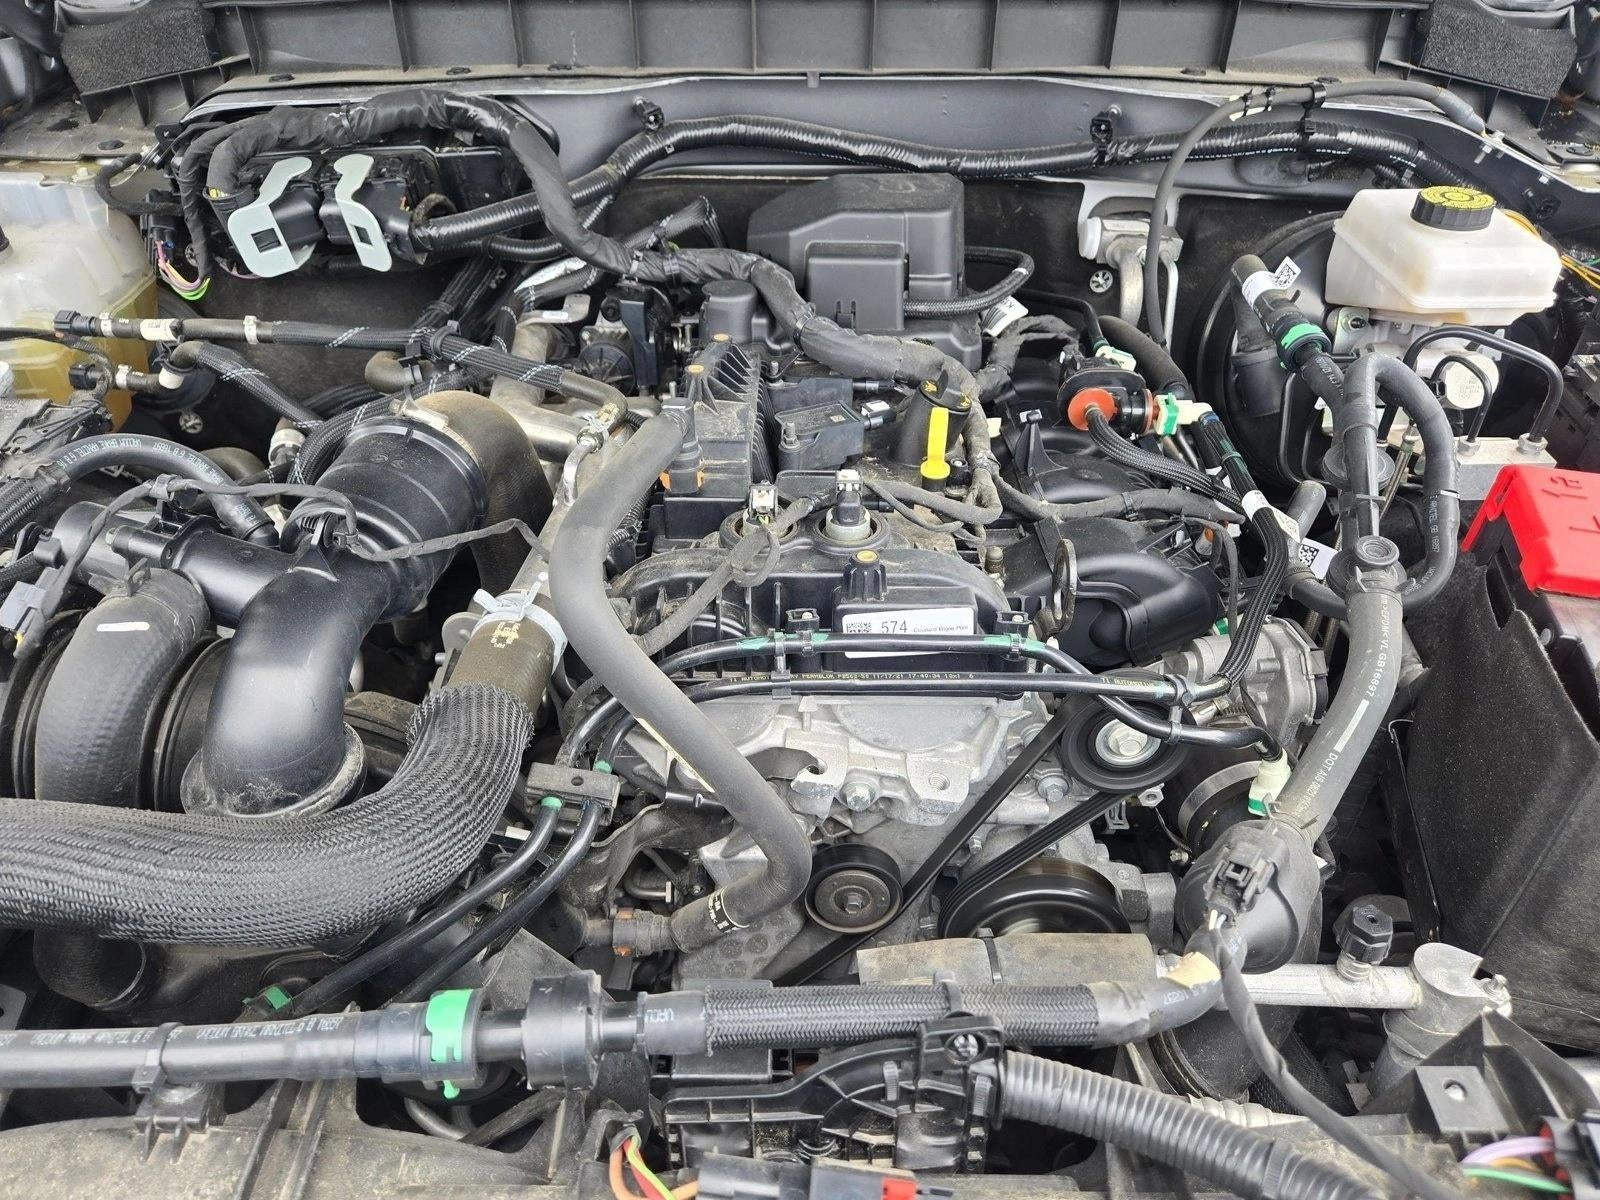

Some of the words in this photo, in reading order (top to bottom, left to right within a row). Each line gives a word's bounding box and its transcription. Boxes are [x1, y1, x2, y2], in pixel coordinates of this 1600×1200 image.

[881, 620, 908, 634] 574
[1366, 653, 1387, 698] GB16897
[1322, 752, 1338, 771] DOT
